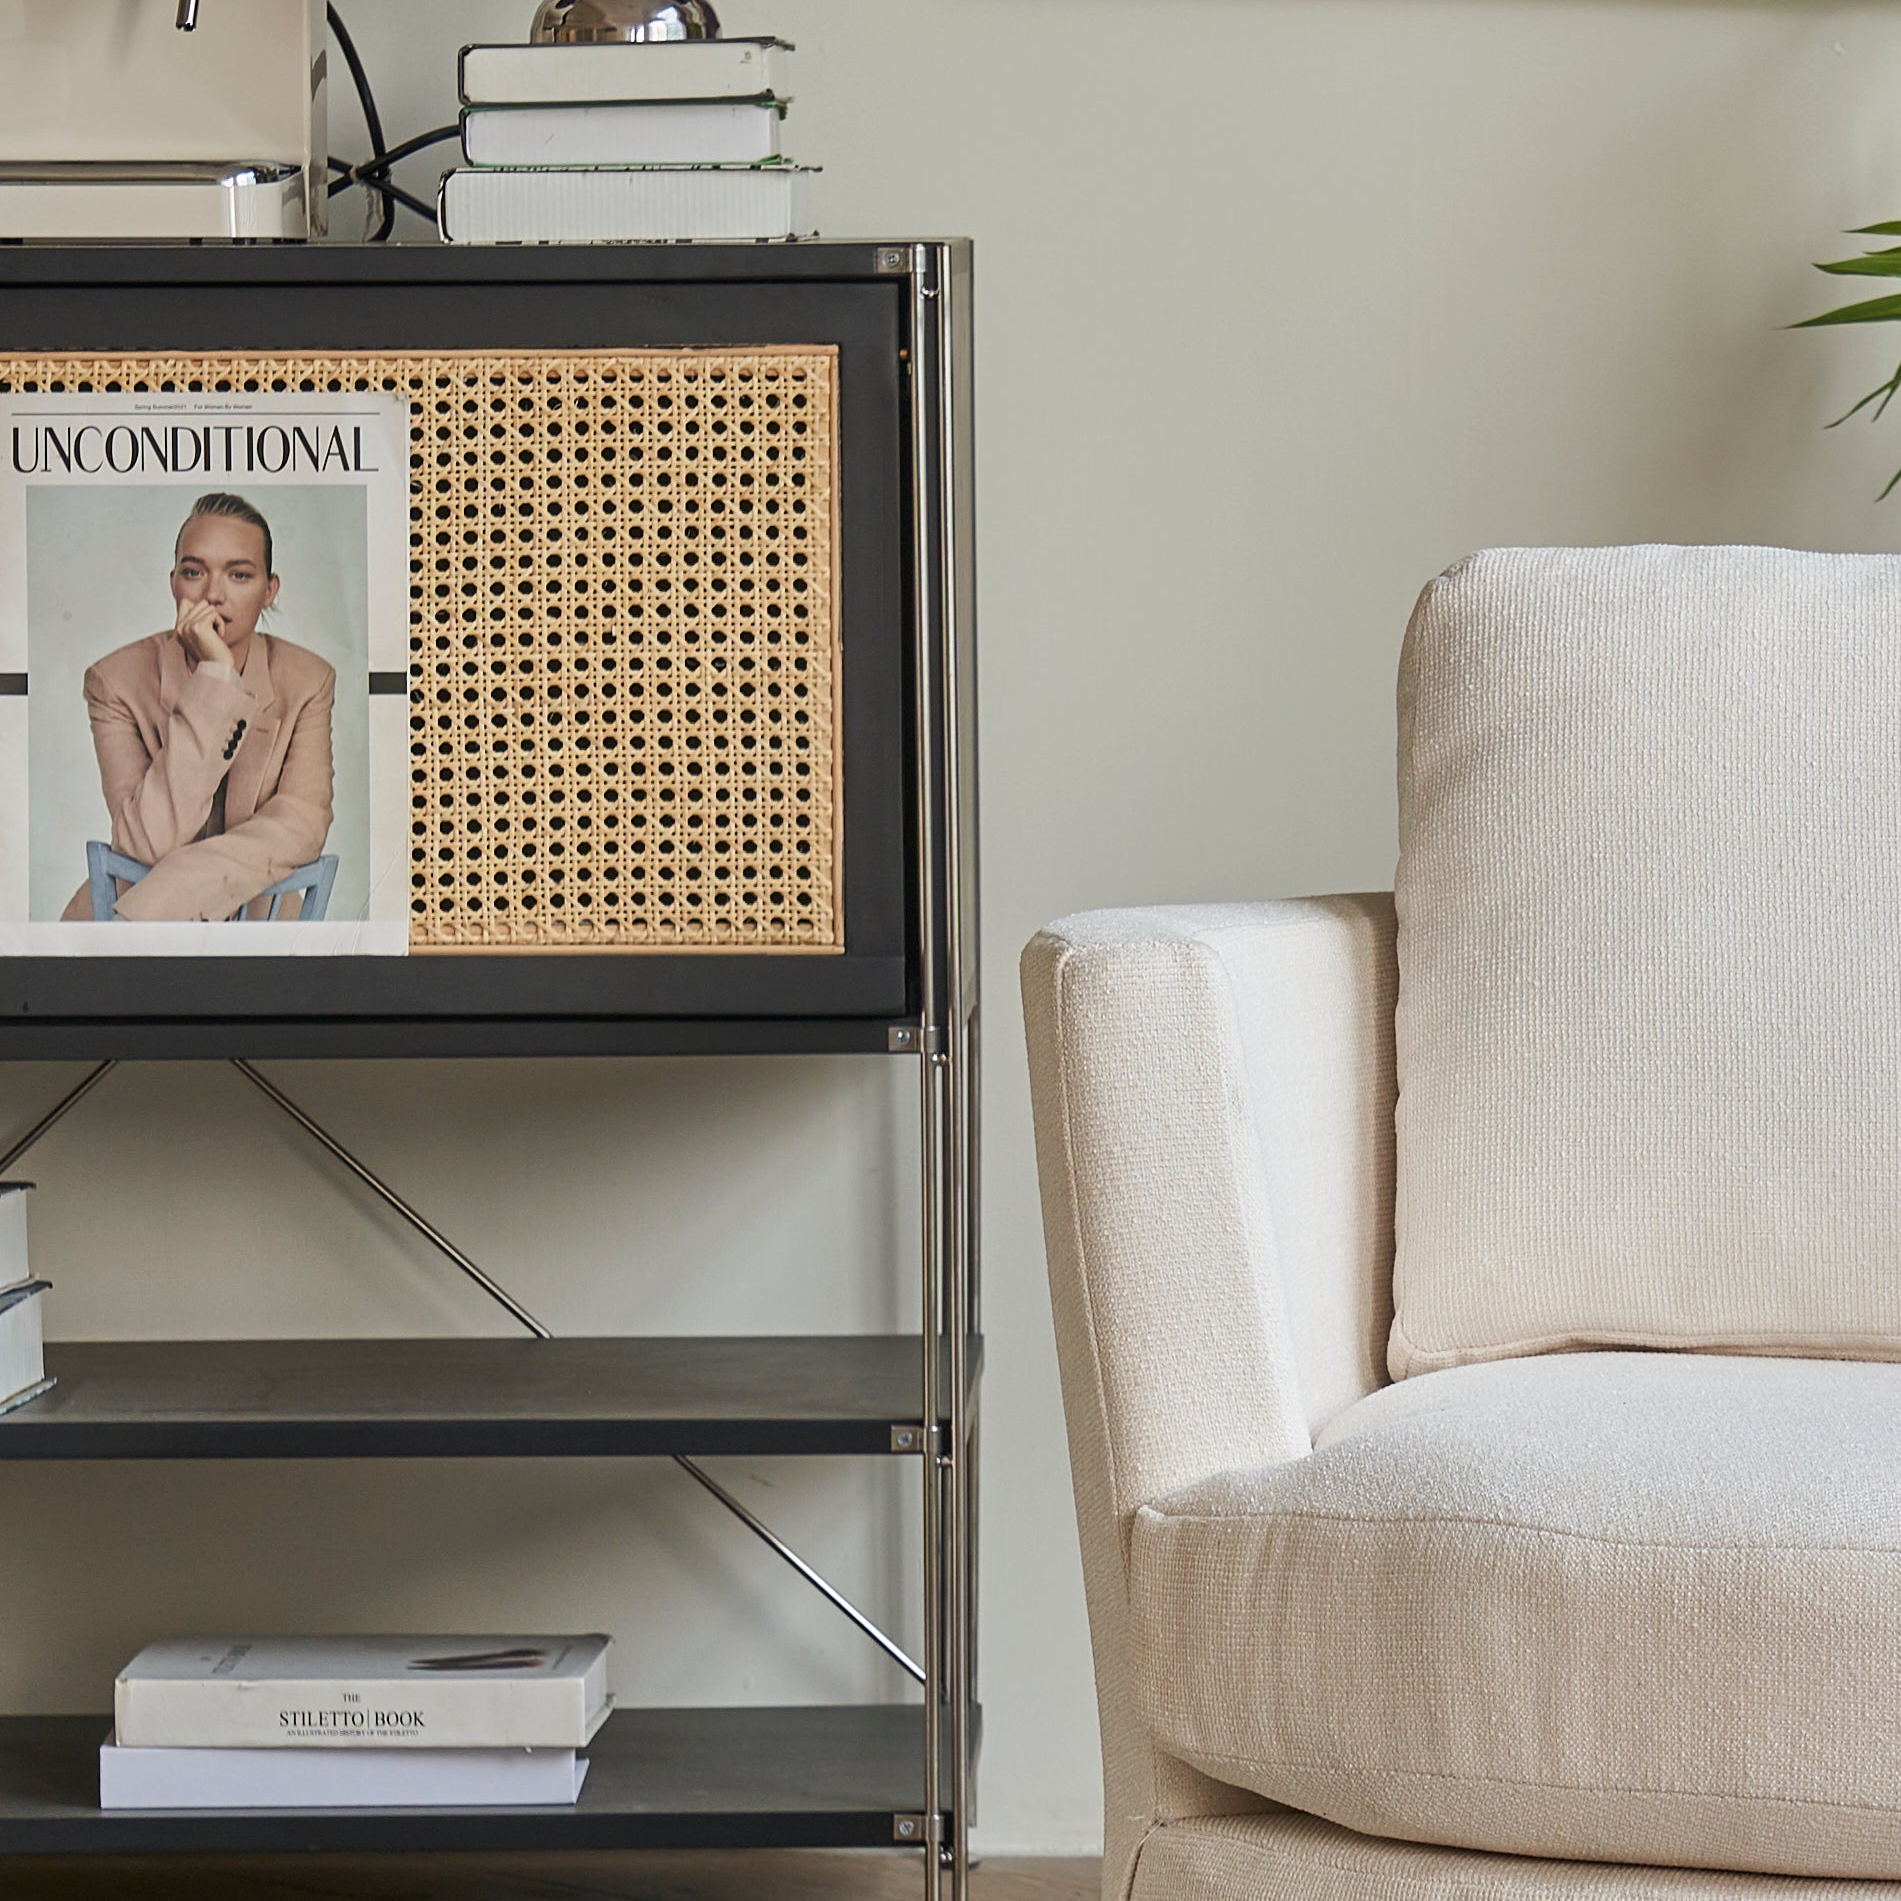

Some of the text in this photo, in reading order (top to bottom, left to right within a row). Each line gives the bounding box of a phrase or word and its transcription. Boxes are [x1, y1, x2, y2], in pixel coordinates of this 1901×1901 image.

[12, 425, 380, 474] UNCONDITIONAL
[343, 1693, 361, 1703] THE
[279, 1710, 425, 1727] STILETTO BOOK
